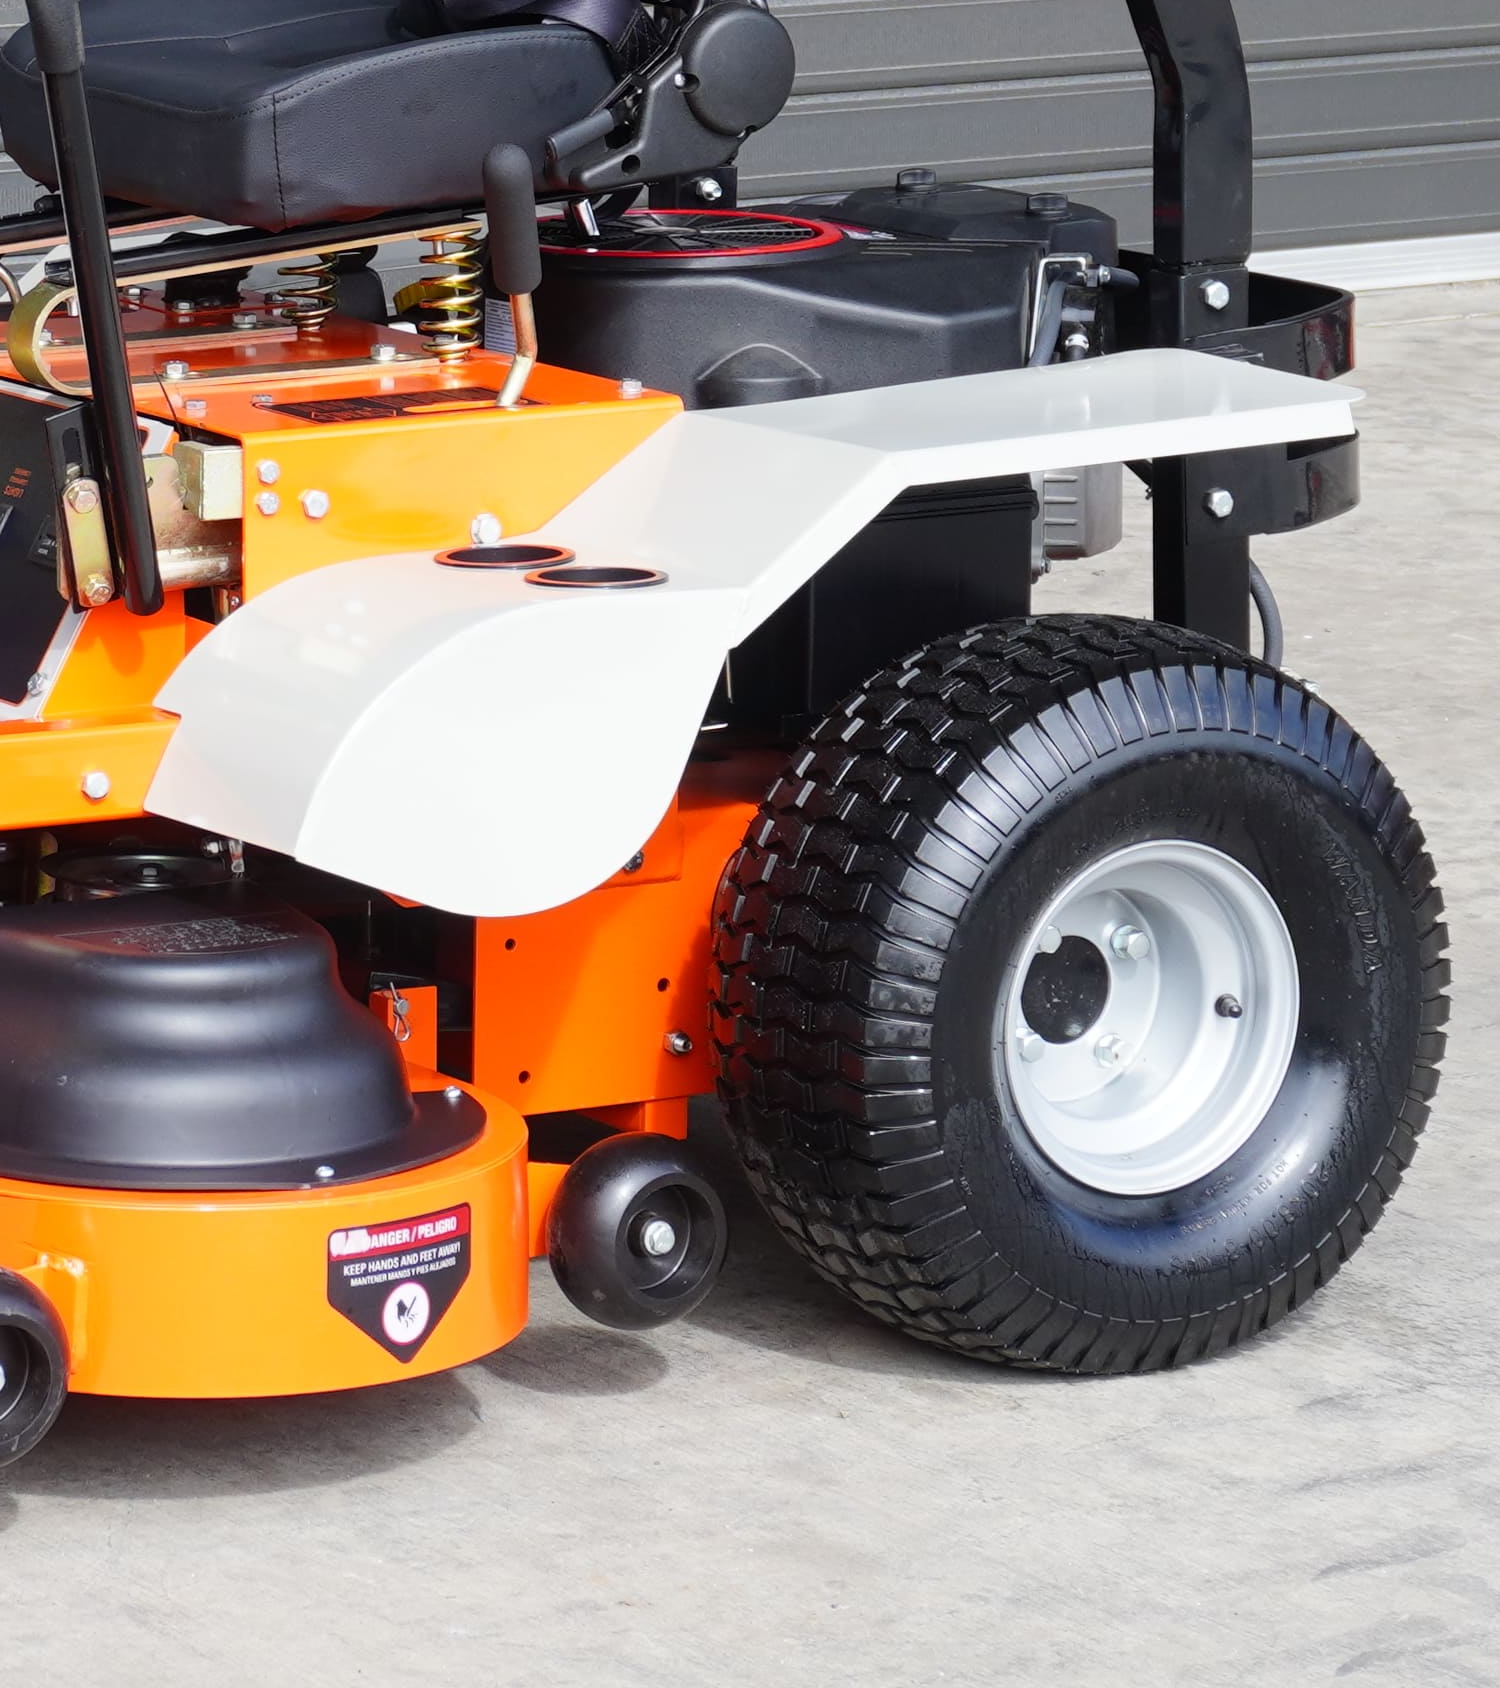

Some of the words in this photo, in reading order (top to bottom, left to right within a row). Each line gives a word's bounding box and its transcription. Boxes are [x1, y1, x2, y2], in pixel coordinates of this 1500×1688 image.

[1322, 842, 1383, 974] WANDA
[418, 1216, 457, 1239] PELIGRO
[343, 1263, 367, 1277] KEEP
[368, 1257, 400, 1273] HANDS
[400, 1253, 419, 1267] AND
[420, 1248, 438, 1263] FEET
[350, 1273, 387, 1287] MANTENER
[387, 1270, 411, 1281] MANOS
